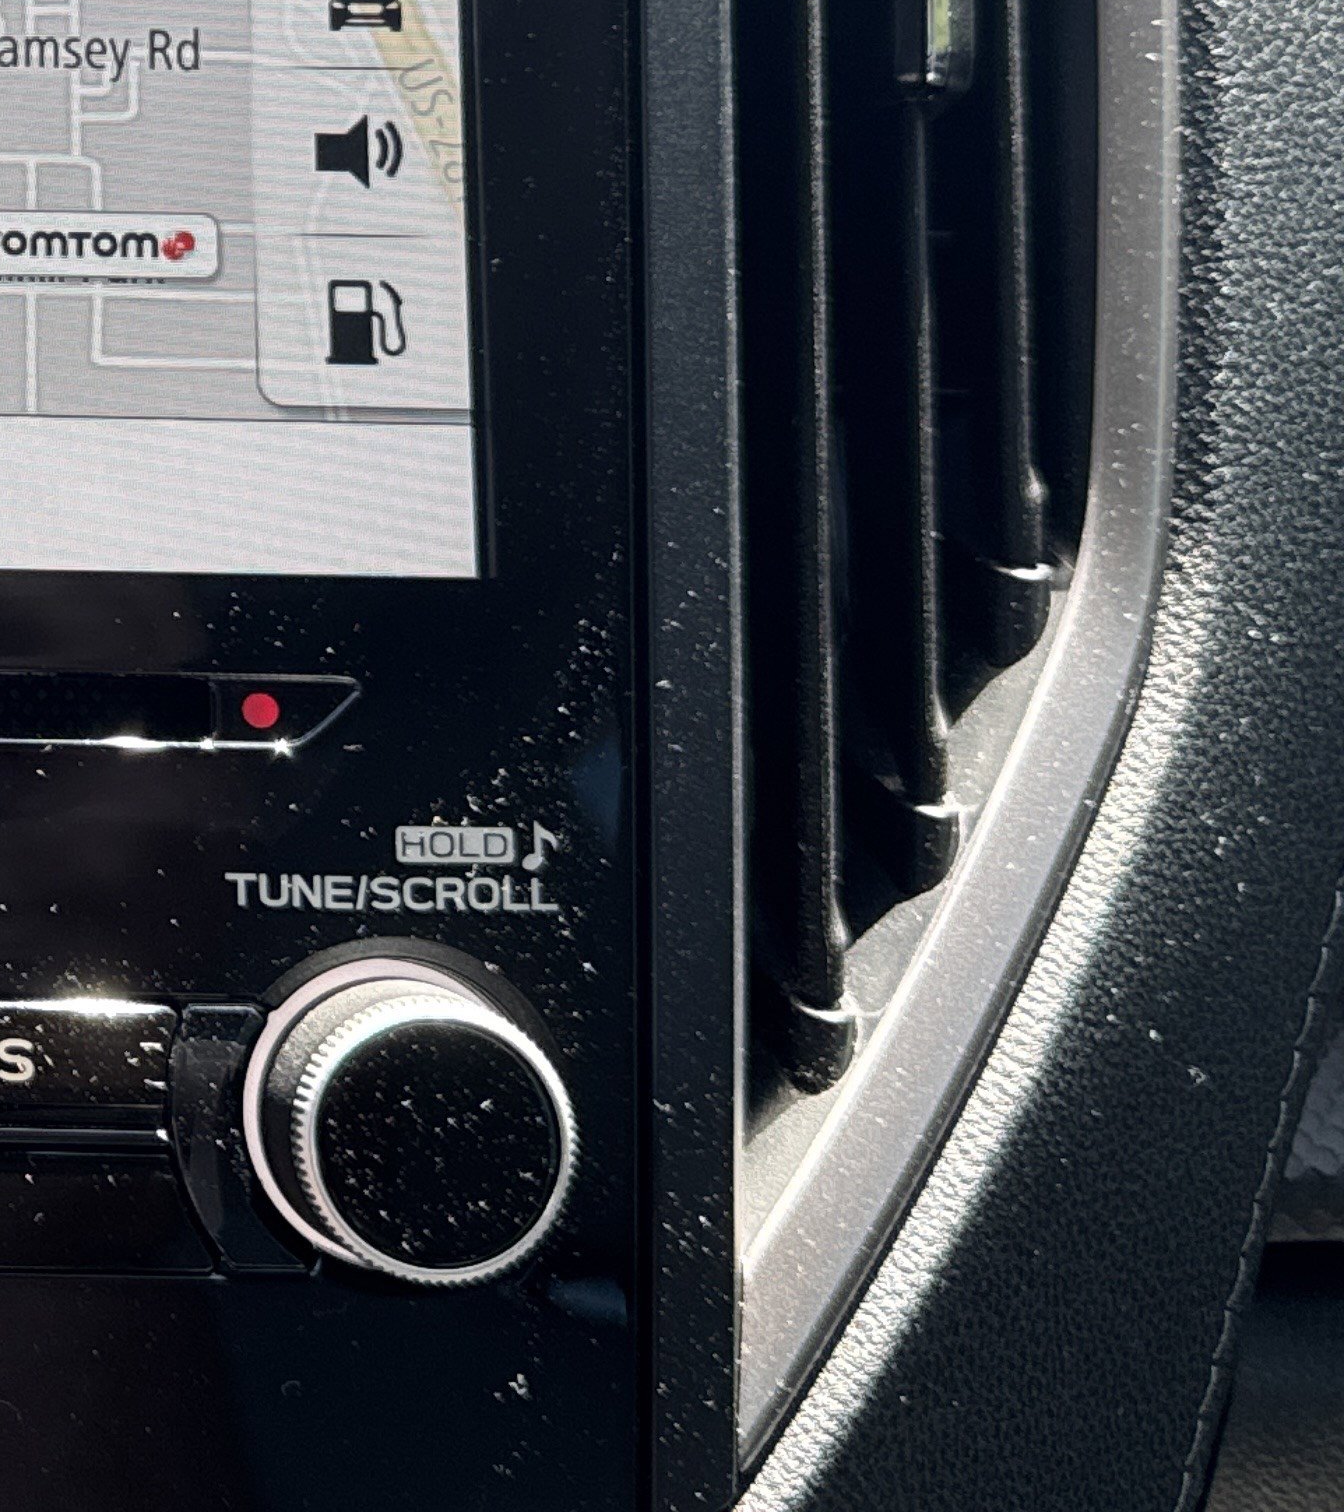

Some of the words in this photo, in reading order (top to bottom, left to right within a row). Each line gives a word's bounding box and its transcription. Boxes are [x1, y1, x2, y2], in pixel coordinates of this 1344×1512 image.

[148, 26, 201, 71] Rd
[401, 830, 510, 859] HOLD
[224, 871, 561, 912] TUNE/SCROLL
